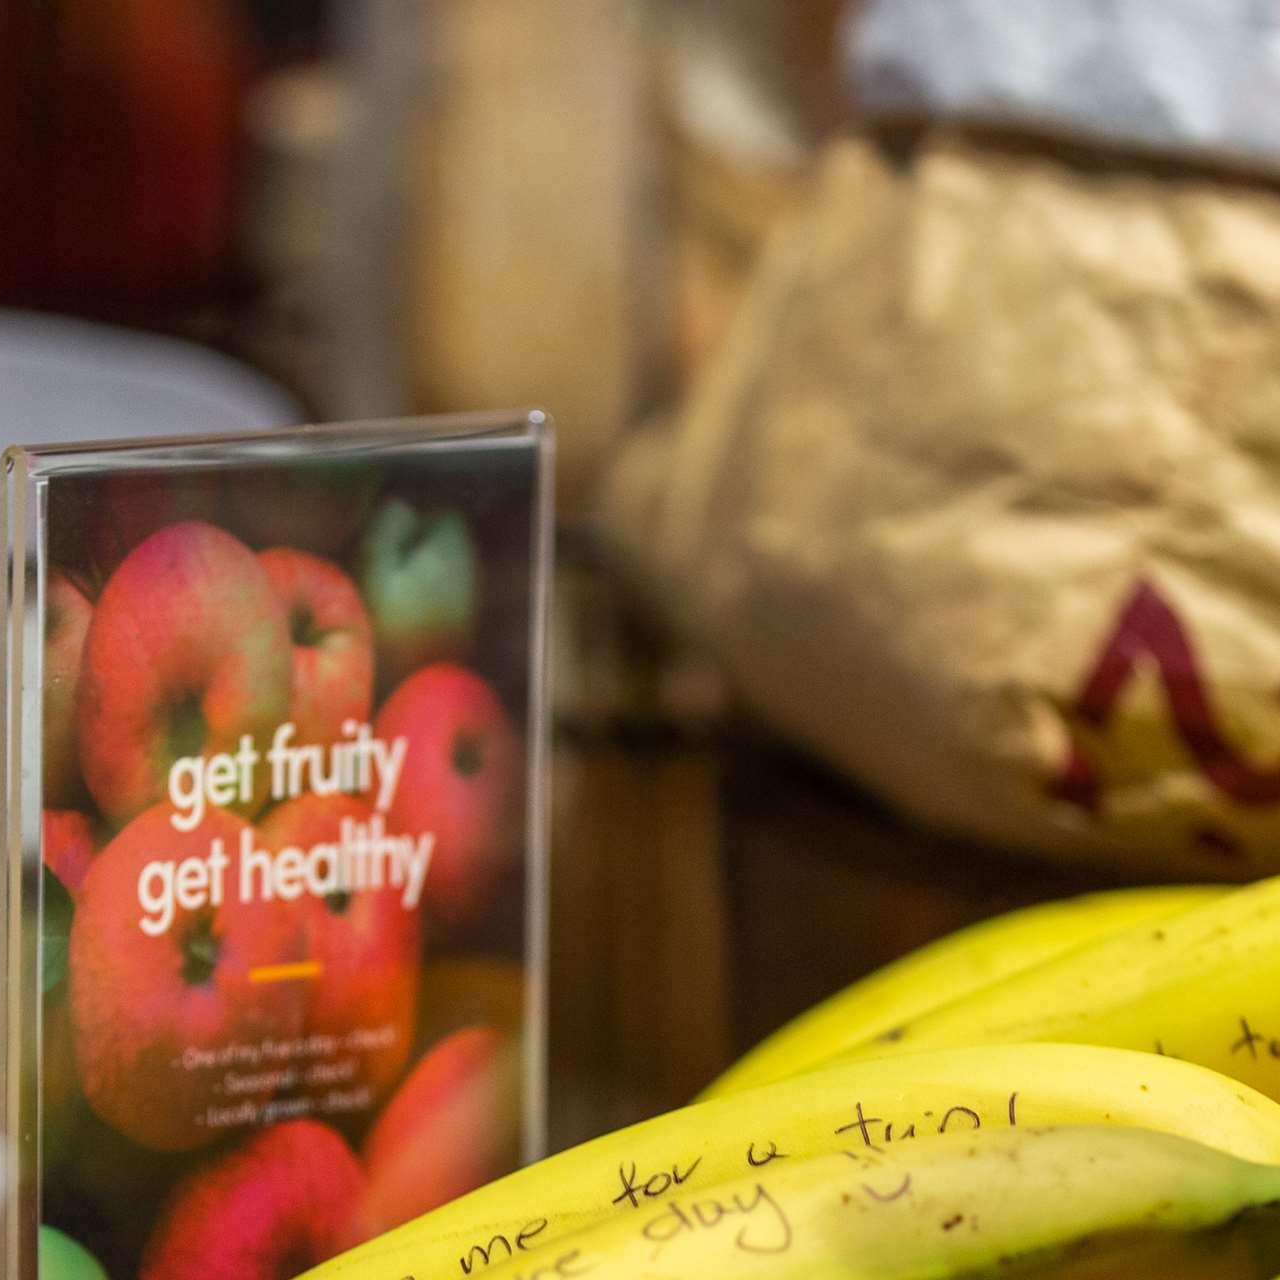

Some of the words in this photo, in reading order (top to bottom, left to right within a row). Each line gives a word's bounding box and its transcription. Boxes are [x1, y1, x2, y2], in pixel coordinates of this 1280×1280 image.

[168, 734, 258, 832] get
[267, 718, 409, 812] fruity
[137, 837, 229, 936] get
[239, 814, 436, 910] healthy
[459, 1216, 548, 1275] me
[612, 1156, 703, 1209] for
[747, 1141, 791, 1167] a
[641, 1182, 793, 1255] day
